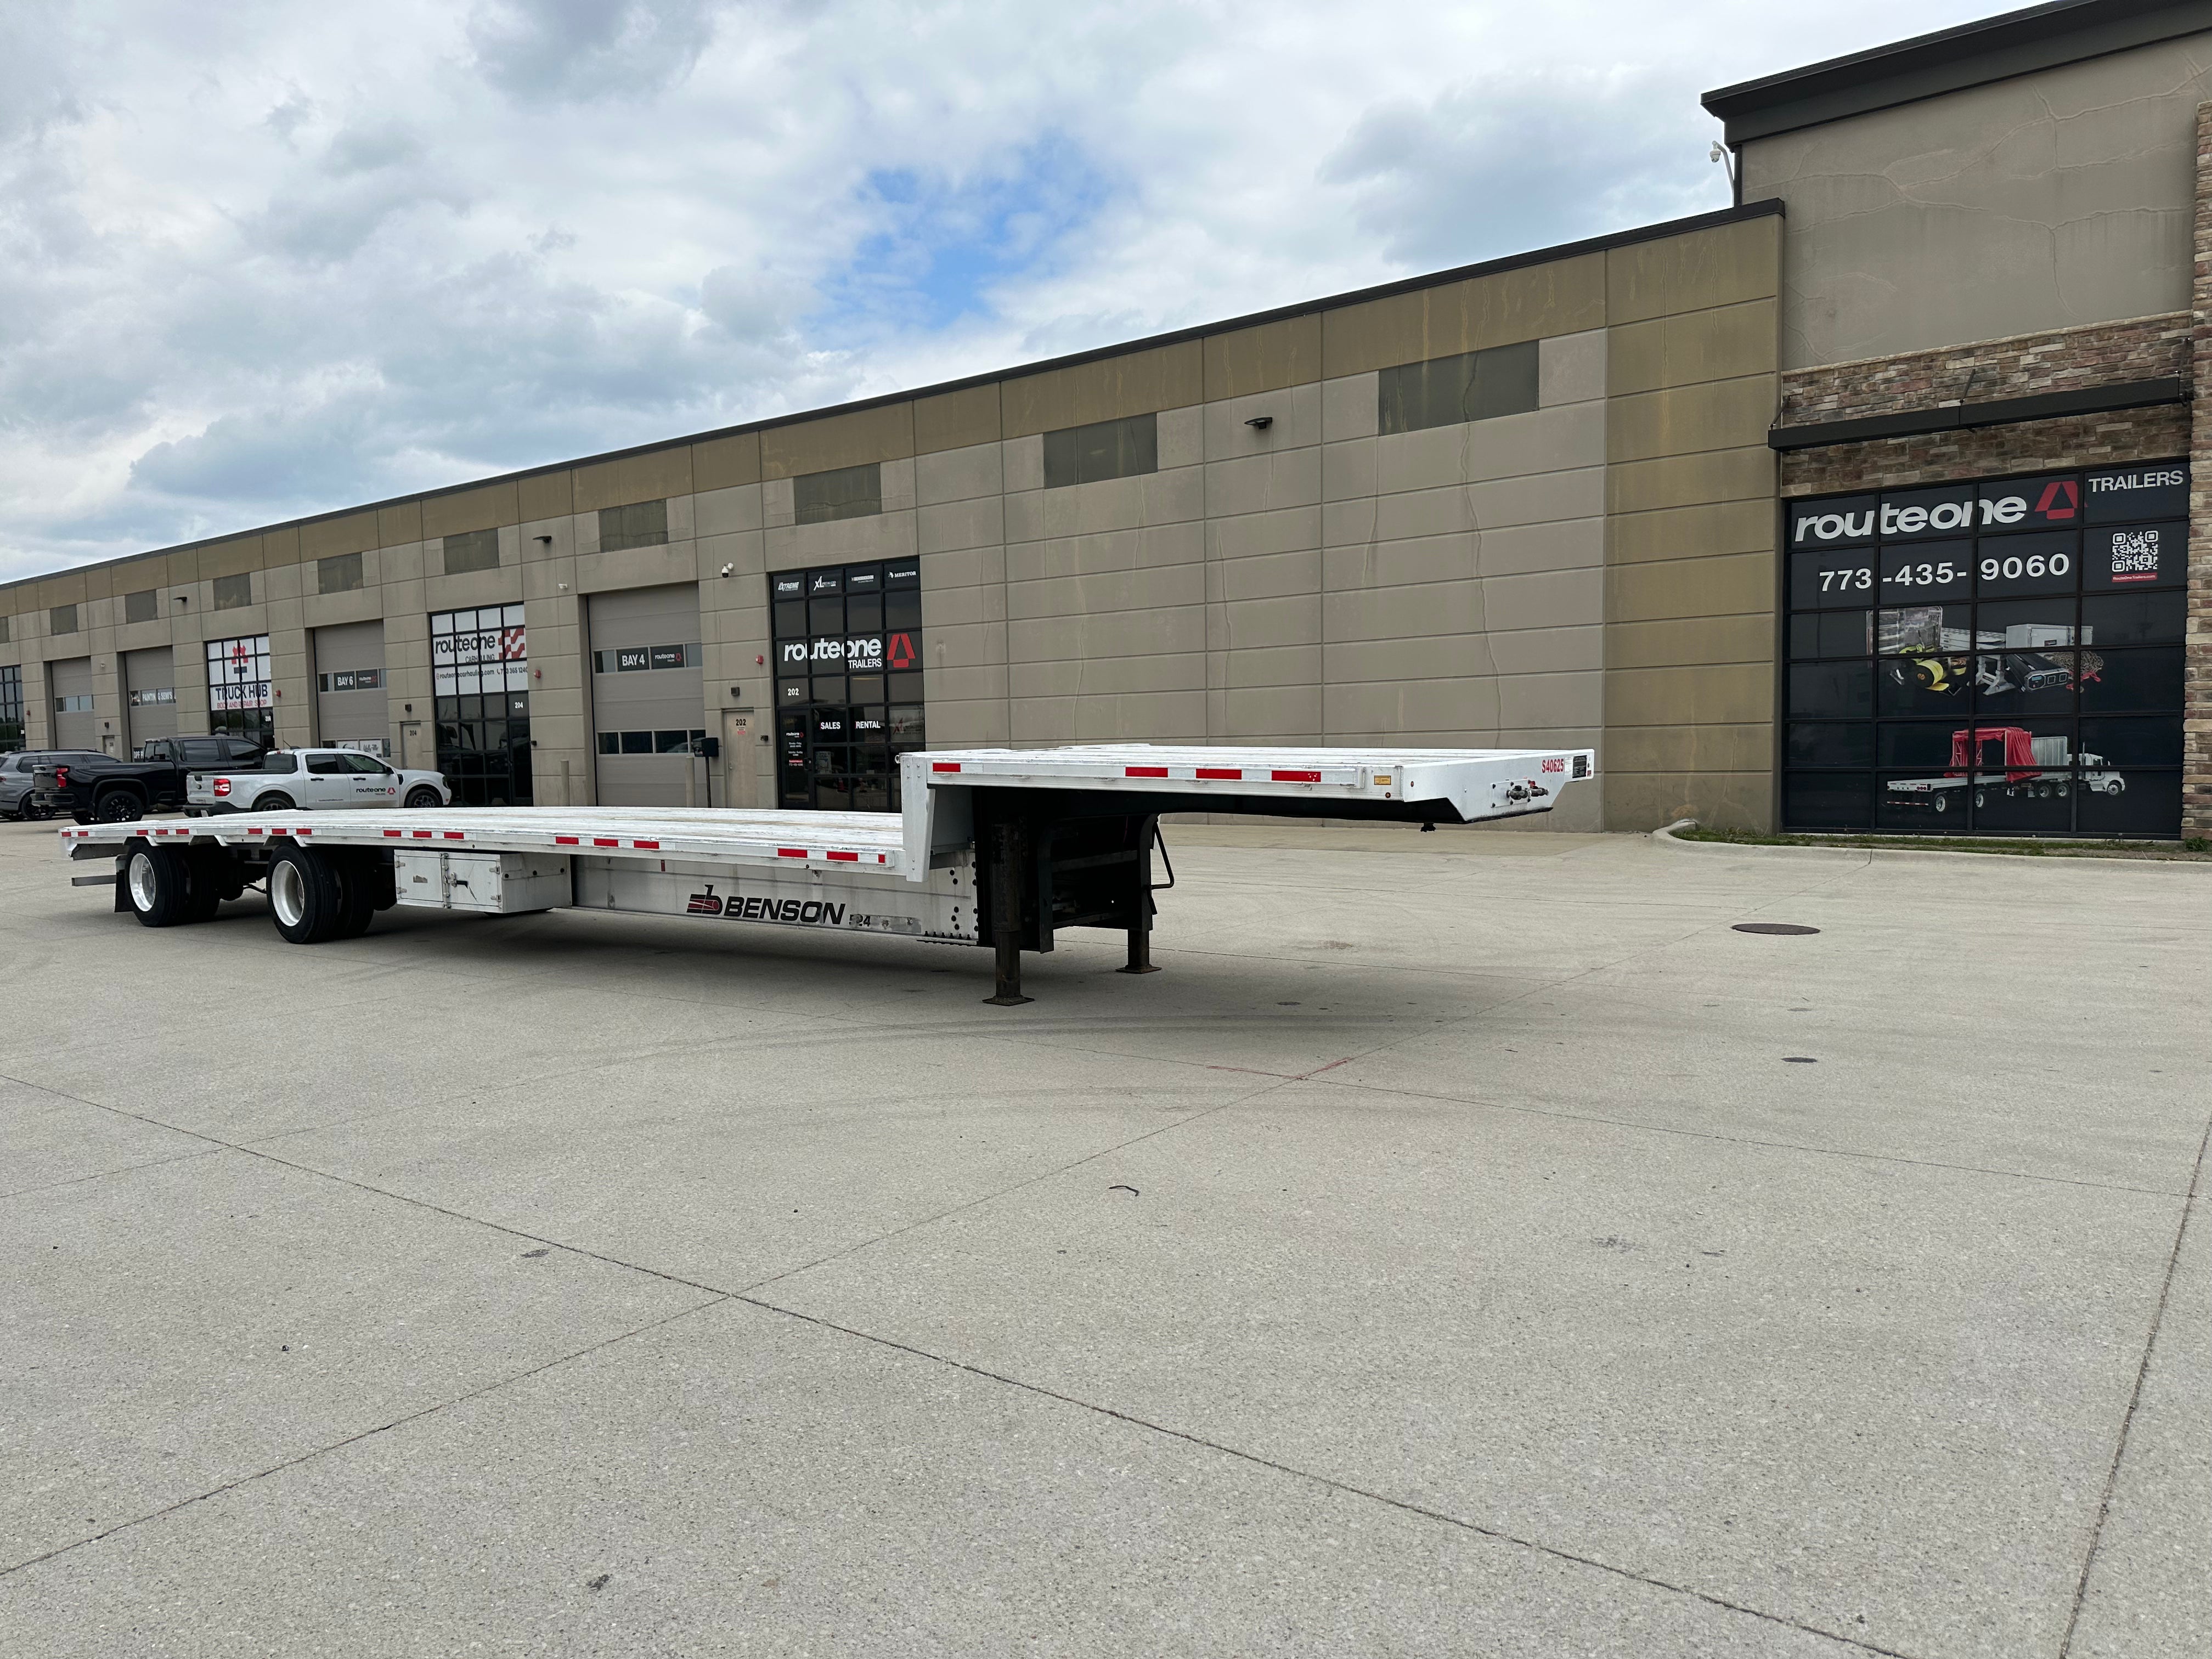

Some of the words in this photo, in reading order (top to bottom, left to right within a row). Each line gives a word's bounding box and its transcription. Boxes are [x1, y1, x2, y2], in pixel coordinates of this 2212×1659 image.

[2088, 470, 2183, 493] TRAILERS
[1795, 496, 2027, 542] routeone
[436, 635, 496, 654] routeone
[784, 637, 882, 662] routeone
[622, 654, 638, 667] BAY
[639, 654, 645, 665] 4
[848, 658, 882, 669] TRAILERS
[337, 676, 348, 686] BAY
[349, 676, 353, 685] 6
[249, 684, 268, 698] HUB
[787, 688, 799, 696] 202
[820, 721, 841, 730] SALES
[855, 720, 881, 729] RENTAL
[1542, 759, 1564, 773] S40625
[724, 895, 846, 925] BENSON
